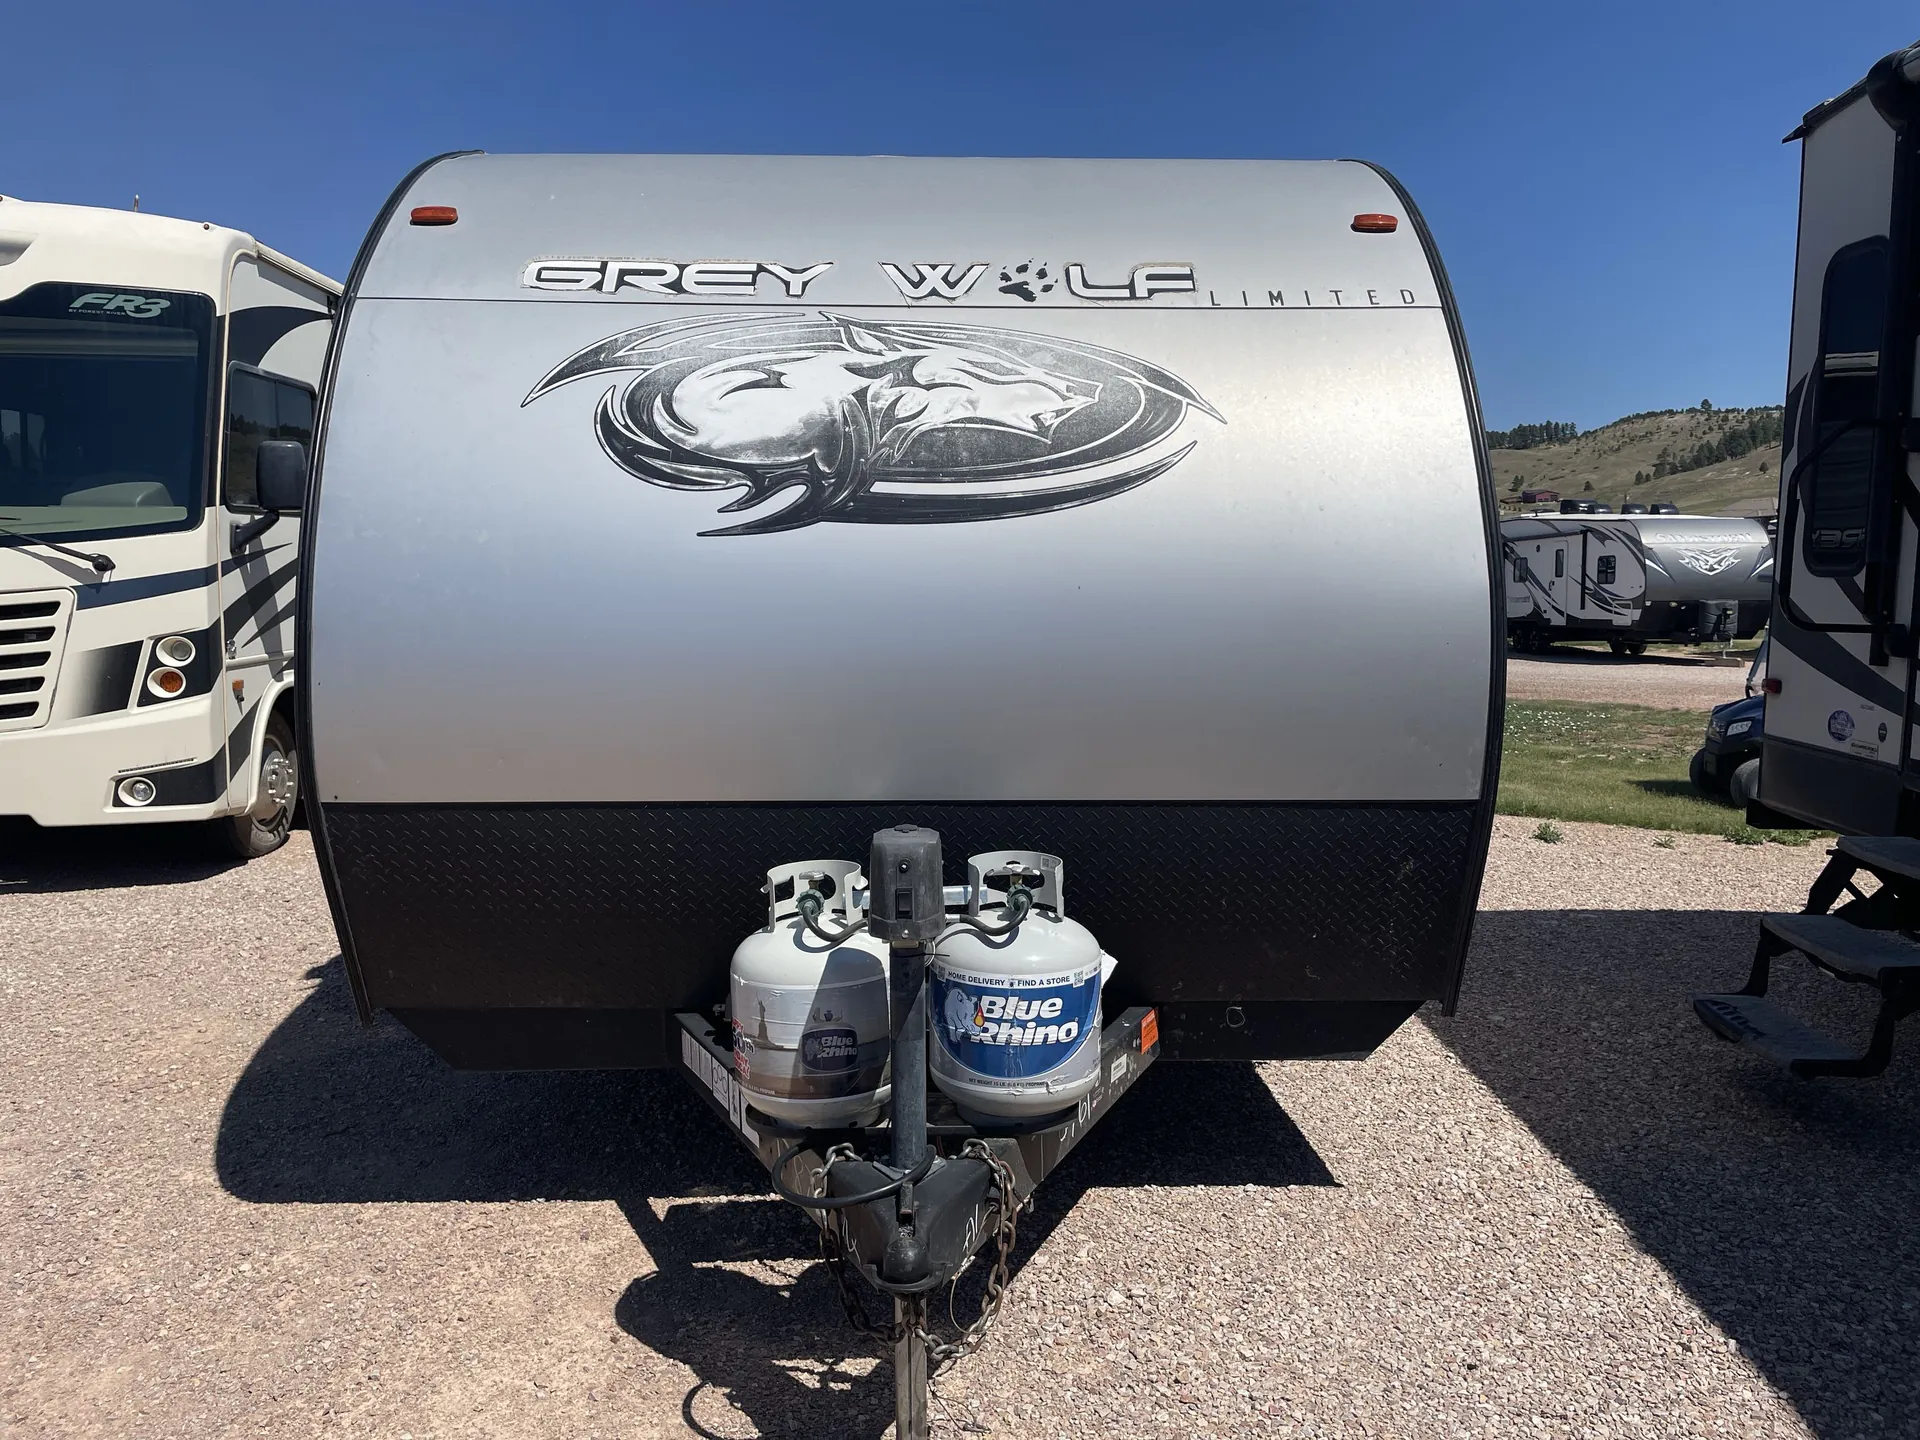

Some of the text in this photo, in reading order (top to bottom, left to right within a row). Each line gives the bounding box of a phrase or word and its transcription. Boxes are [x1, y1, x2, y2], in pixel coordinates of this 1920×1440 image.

[522, 260, 834, 297] GREY
[69, 292, 171, 319] FR3
[1209, 289, 1416, 307] LIMITED
[948, 971, 1071, 988] HOME DELIVERY FIND A STORE
[980, 995, 1064, 1020] Blue
[821, 1035, 854, 1047] Blue
[971, 1019, 1079, 1046] Rhino
[817, 1045, 858, 1059] Rhino
